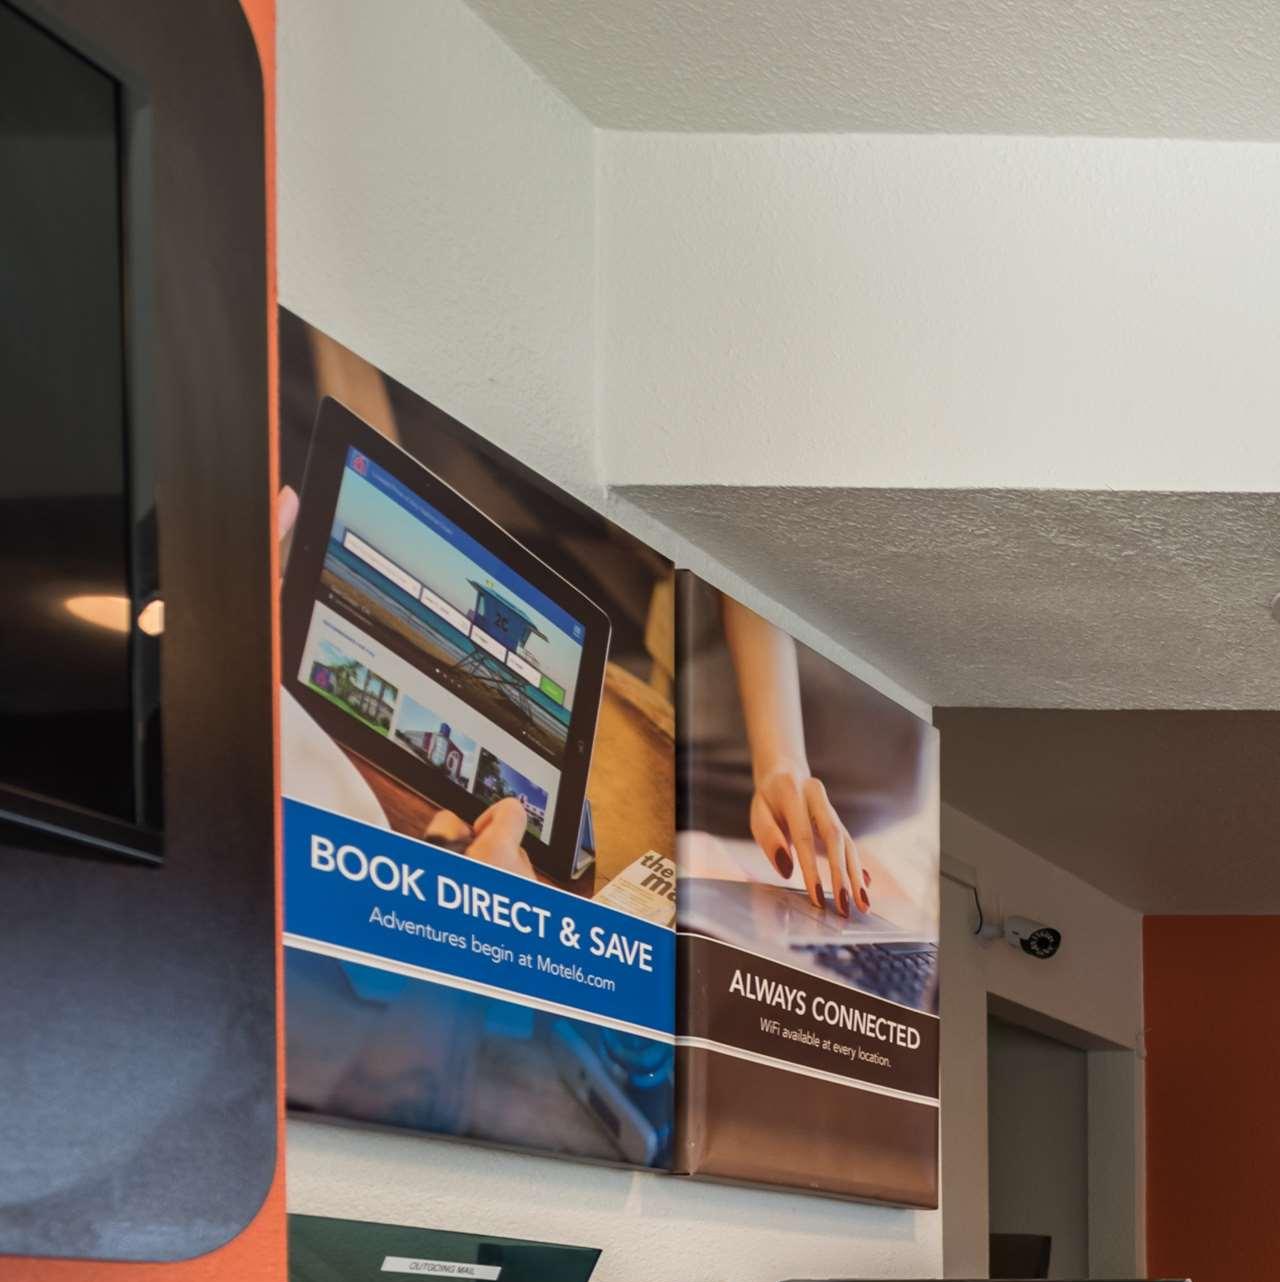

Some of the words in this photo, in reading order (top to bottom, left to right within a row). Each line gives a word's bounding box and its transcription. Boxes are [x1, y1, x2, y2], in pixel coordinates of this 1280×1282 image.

[310, 834, 426, 901] BOOK
[437, 875, 551, 938] DIRECT
[559, 916, 580, 949] &
[590, 926, 653, 972] SAVE
[640, 854, 674, 878] the
[369, 906, 466, 948] Adventures
[471, 935, 513, 964] begin
[519, 954, 533, 969] at
[537, 955, 616, 992] Motel6.com
[729, 970, 806, 1015] ALWAYS
[812, 997, 920, 1049] CONNECTED
[760, 1017, 781, 1033] WiFi
[782, 1025, 820, 1048] available
[822, 1039, 832, 1050] at
[833, 1043, 856, 1061] every
[858, 1047, 892, 1068] location.
